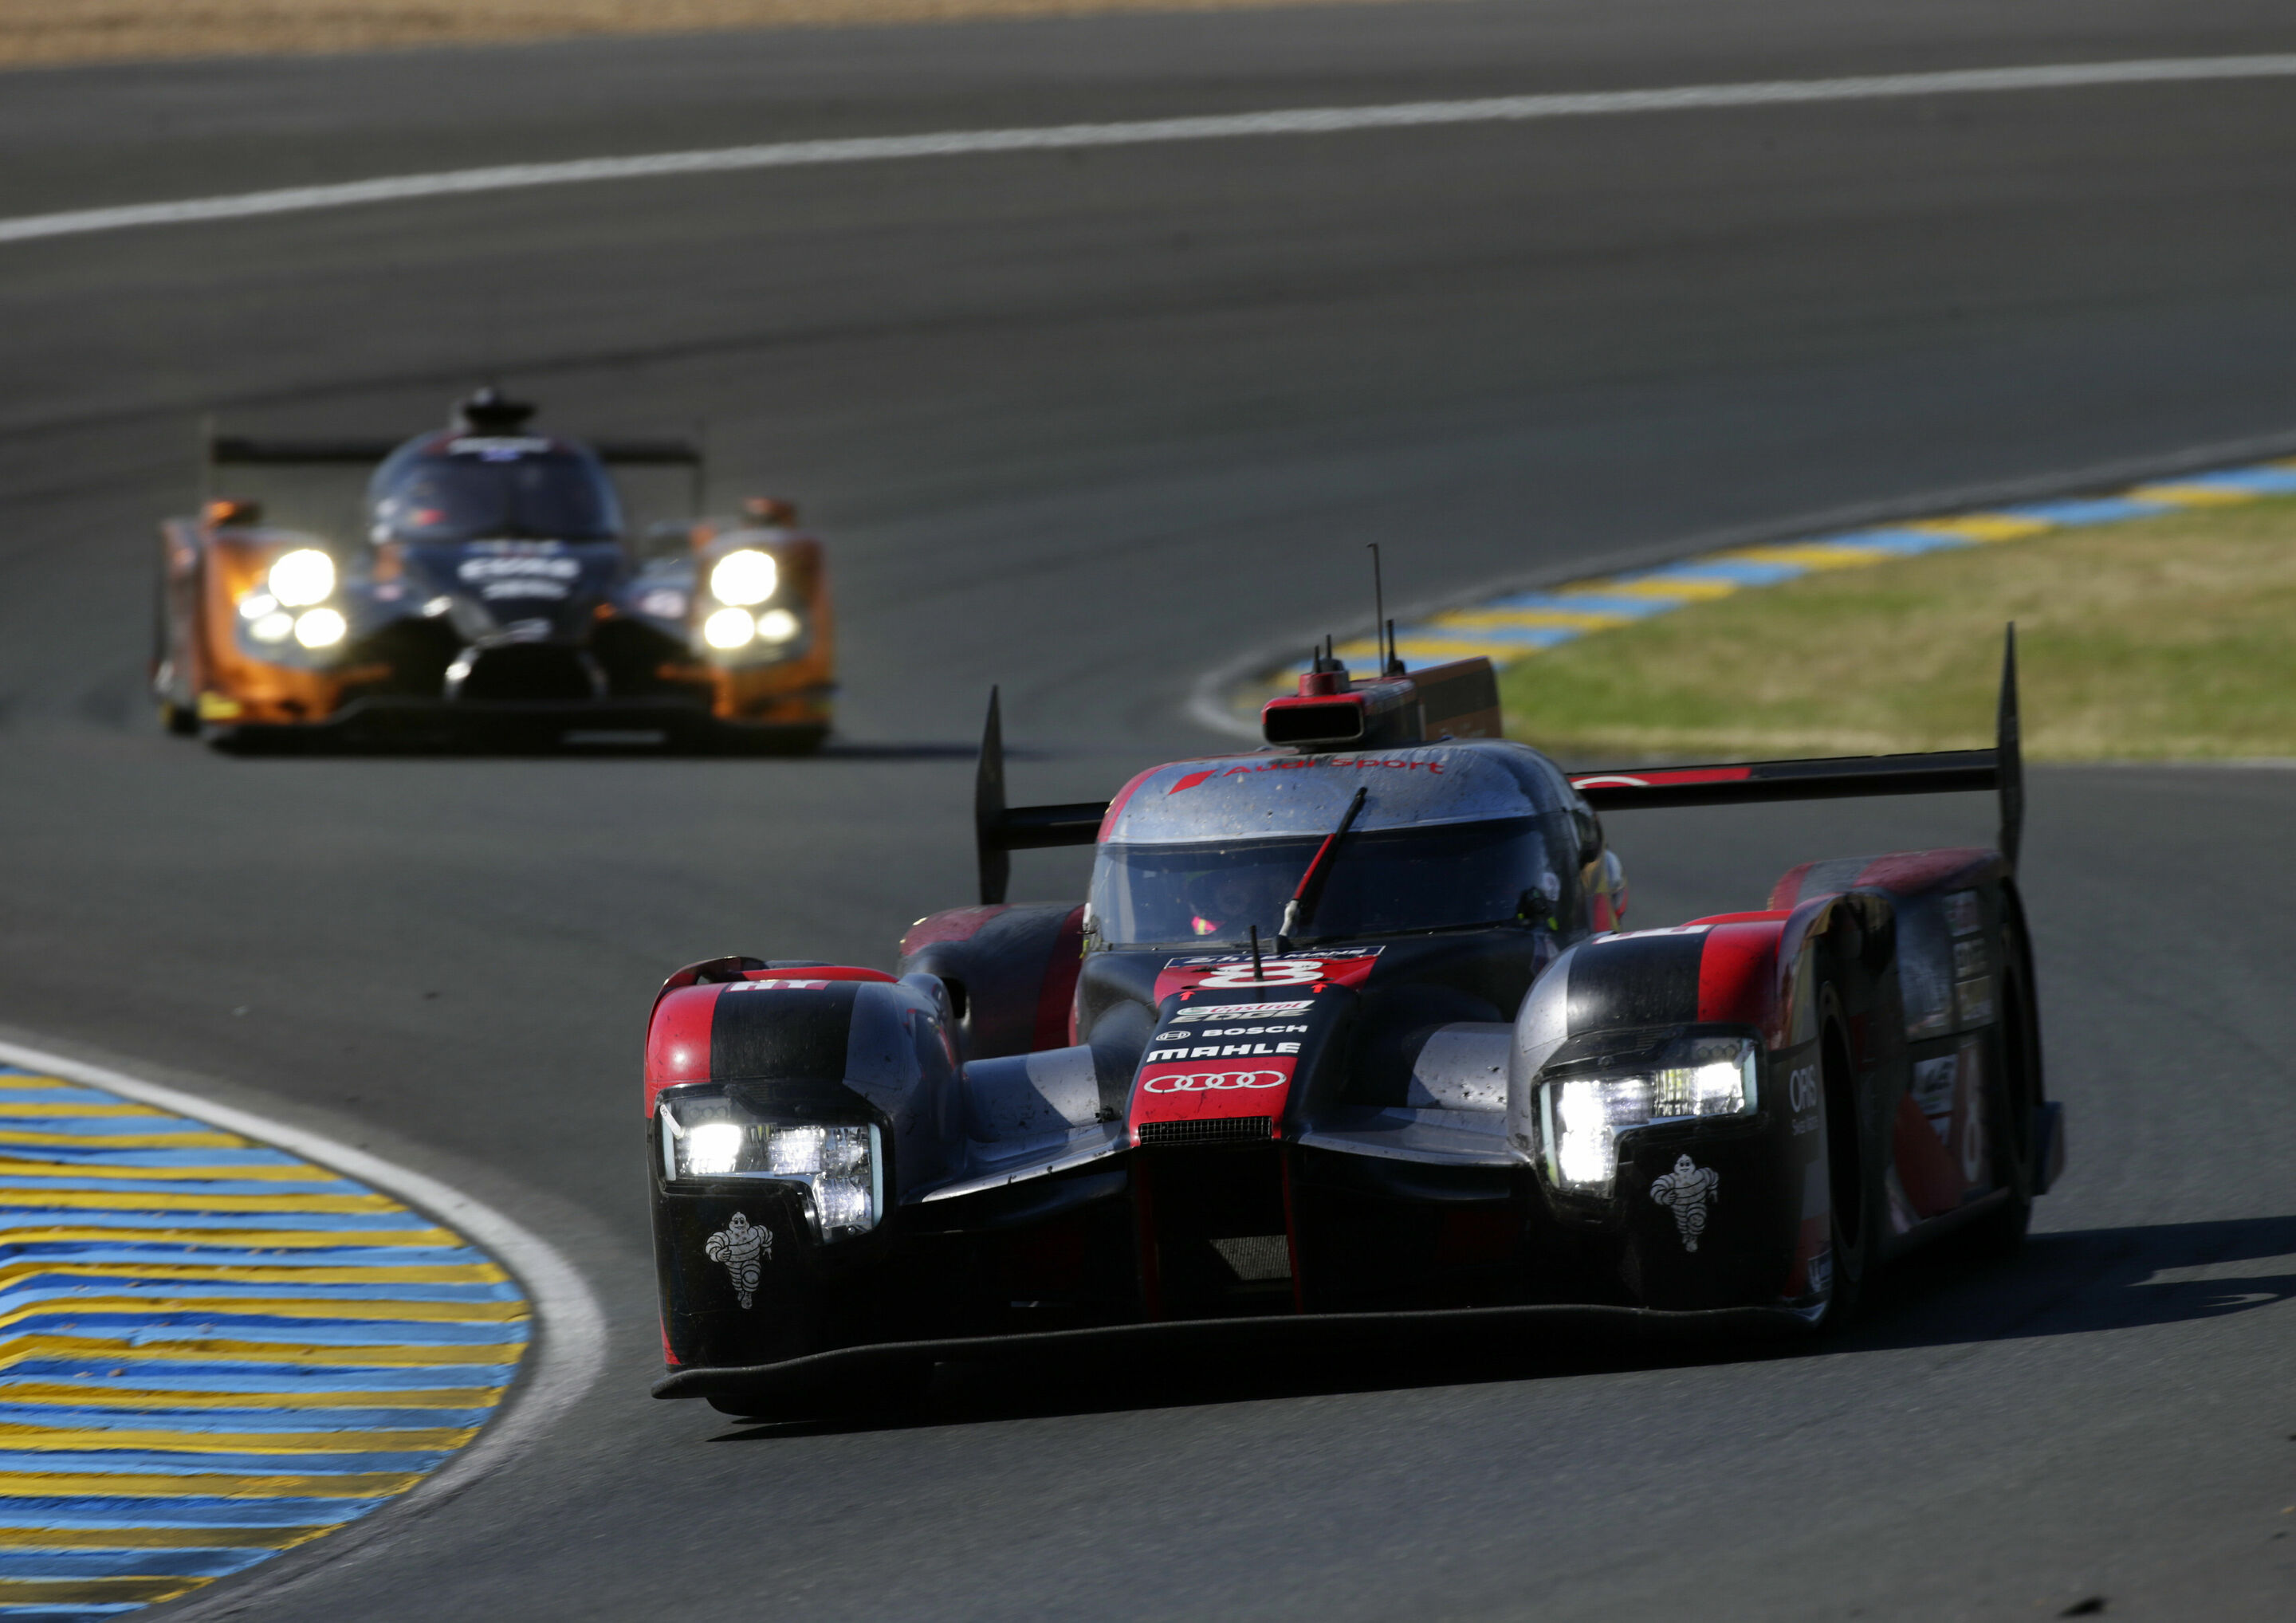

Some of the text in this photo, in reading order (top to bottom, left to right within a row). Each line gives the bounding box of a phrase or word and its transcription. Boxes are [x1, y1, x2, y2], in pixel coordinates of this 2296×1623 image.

[1223, 758, 1444, 777] Audi Sport
[1198, 961, 1324, 987] 8
[1168, 1008, 1312, 1024] EDGE
[1211, 1002, 1301, 1013] Castrol
[1202, 1025, 1307, 1037] BOSCH
[1146, 1043, 1301, 1063] MAHLE
